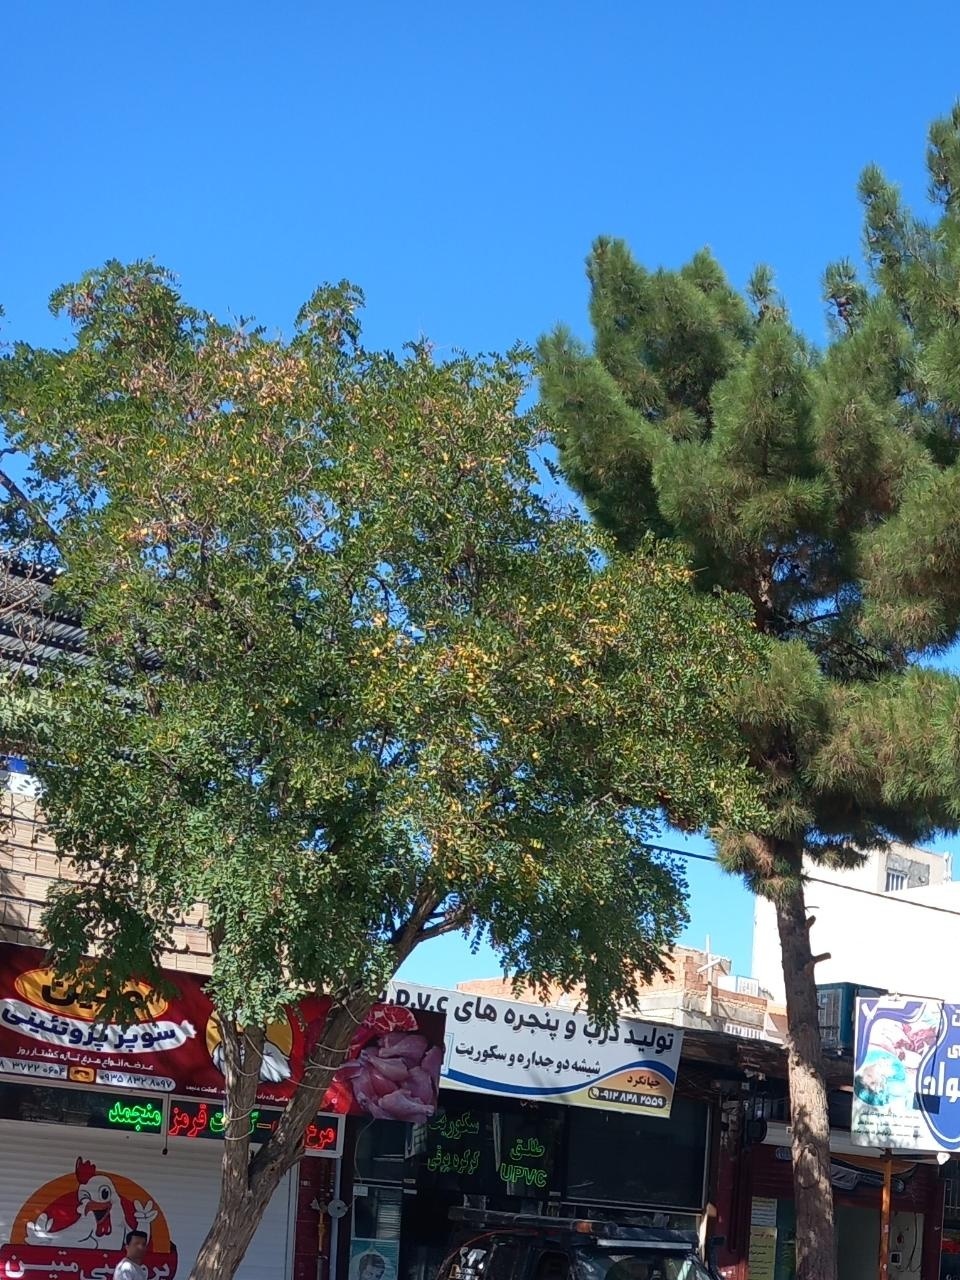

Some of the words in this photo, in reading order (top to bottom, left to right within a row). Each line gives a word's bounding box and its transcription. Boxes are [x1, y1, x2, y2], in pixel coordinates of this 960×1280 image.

[454, 996, 498, 1022] های
[2, 1008, 108, 1050] پروتئینی
[504, 1008, 559, 1040] پنجره
[564, 1020, 576, 1039] و
[583, 1022, 620, 1044] درب
[114, 1027, 176, 1052] سوپر
[624, 1028, 674, 1054] تولید
[16, 1046, 31, 1056] روز
[31, 1048, 59, 1058] کشتار
[60, 1052, 80, 1061] تازه
[81, 1055, 101, 1065] مرغ
[455, 1043, 506, 1062] سکوریت
[507, 1053, 515, 1066] و
[518, 1051, 553, 1071] جداره
[102, 1058, 124, 1068] انواع
[555, 1059, 569, 1073] دو
[572, 1058, 600, 1077] شیشه
[108, 1102, 162, 1131] منجمد
[168, 1103, 208, 1137] قرمز
[305, 1124, 336, 1149] مرغ
[500, 1163, 548, 1188] UPVC
[5, 1251, 79, 1279] متین
